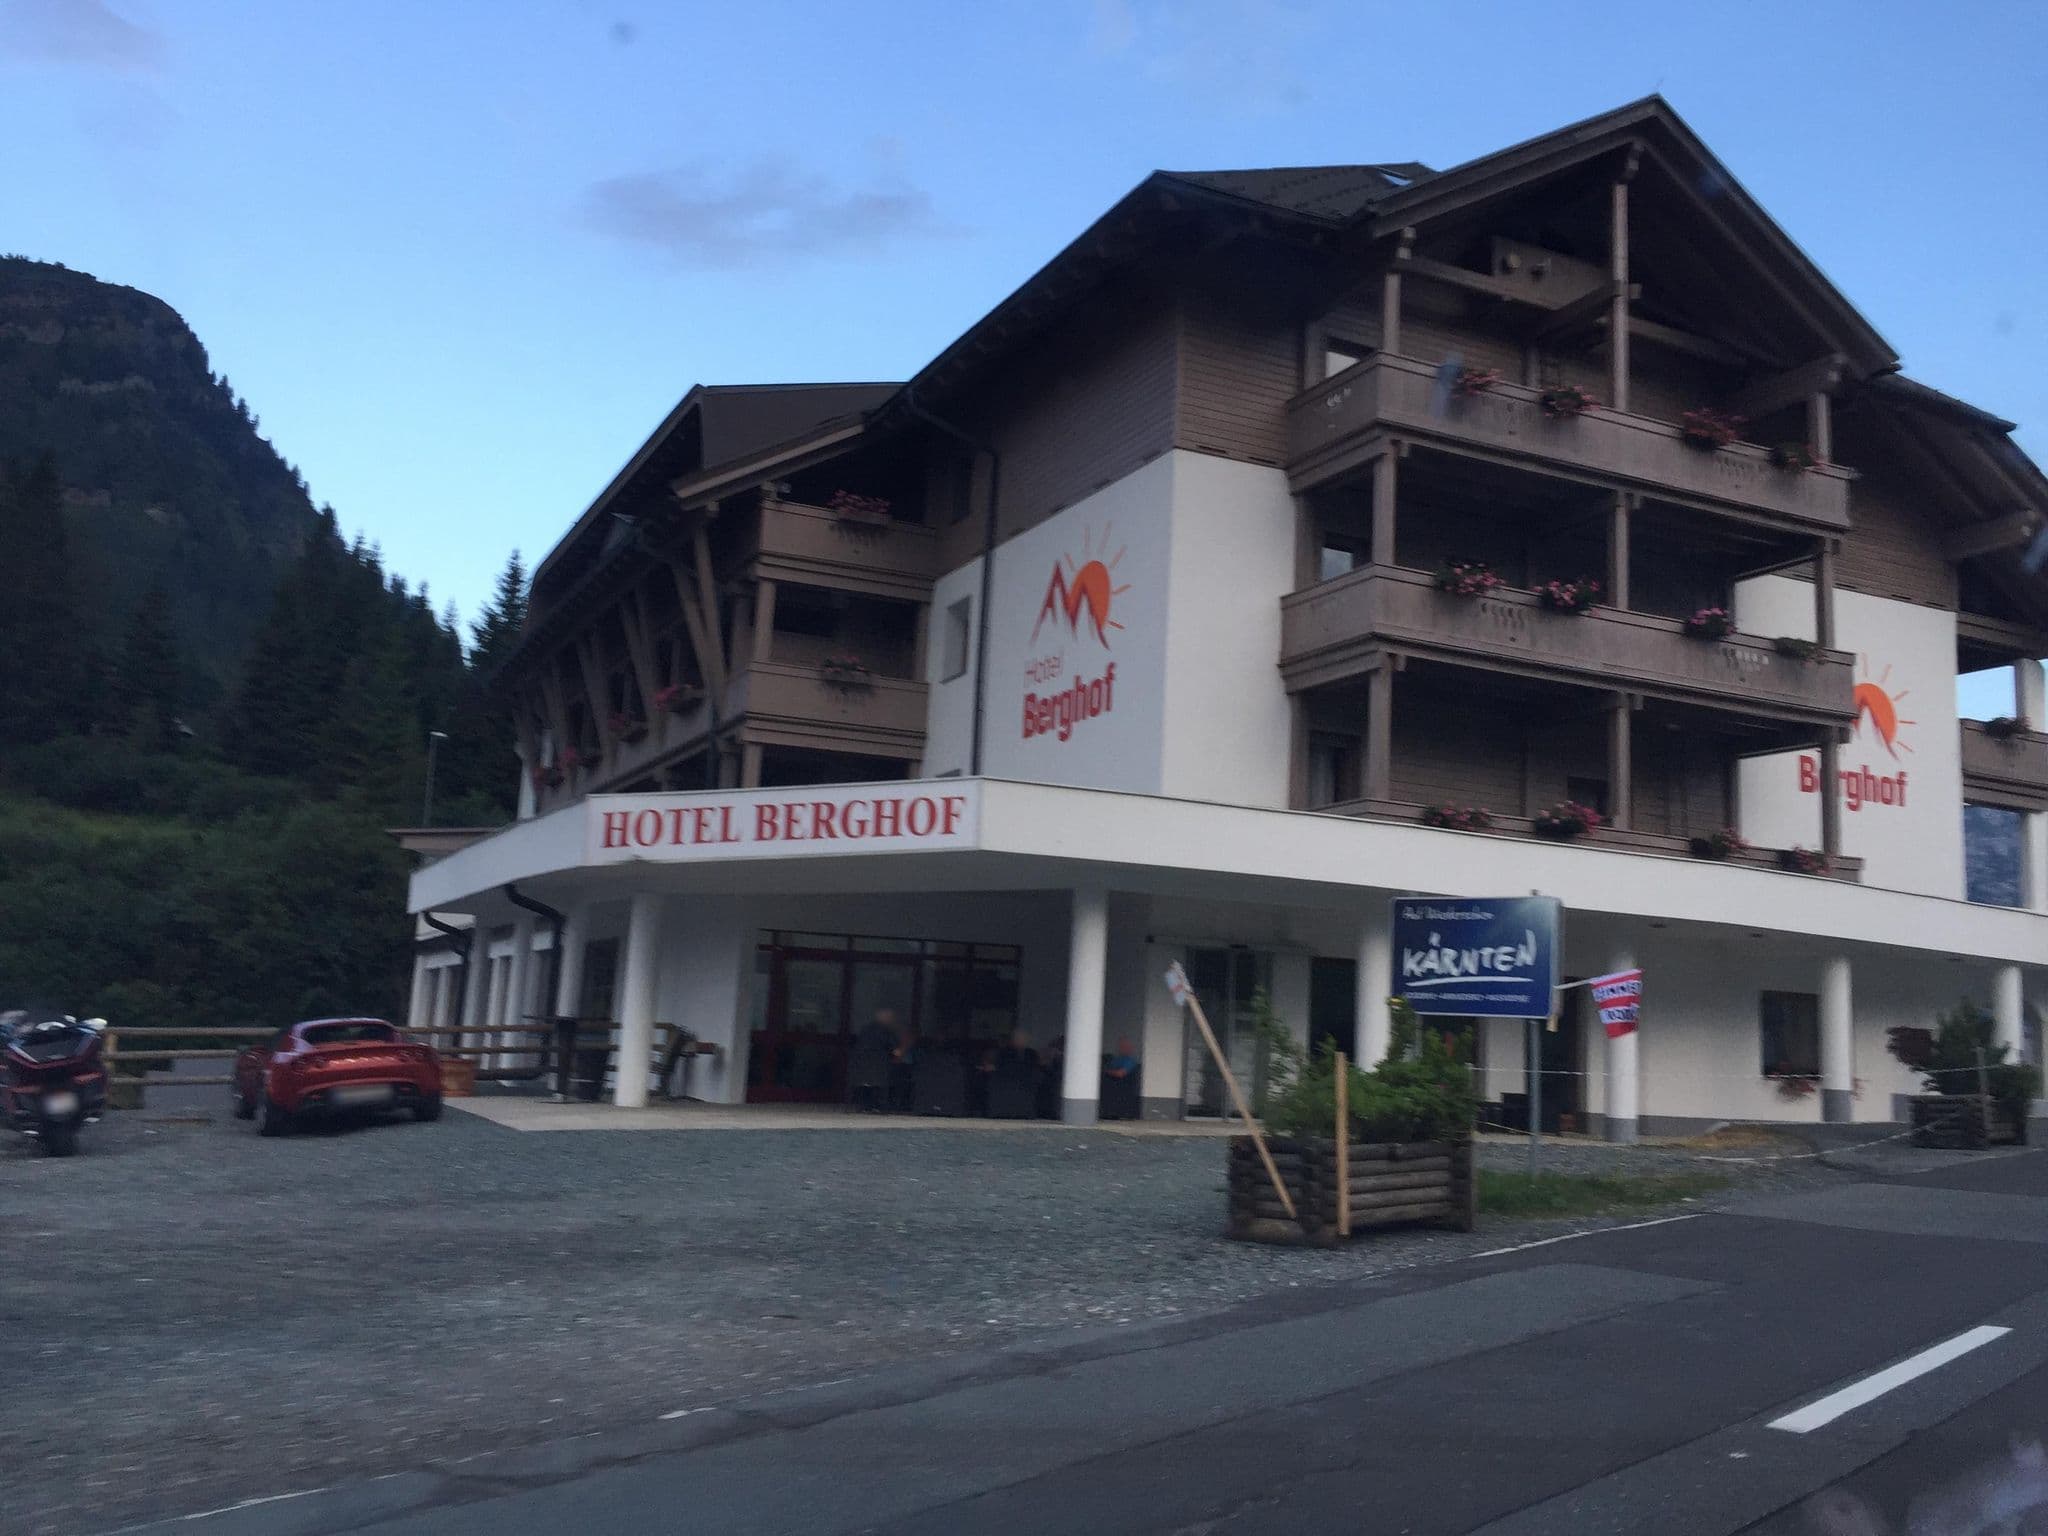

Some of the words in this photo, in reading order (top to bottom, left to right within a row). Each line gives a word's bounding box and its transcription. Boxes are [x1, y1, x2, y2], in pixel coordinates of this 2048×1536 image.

[1022, 661, 1116, 742] Berghof
[1799, 755, 1908, 811] Bghof
[602, 806, 739, 849] HOTEL
[754, 795, 965, 841] BERGHOF
